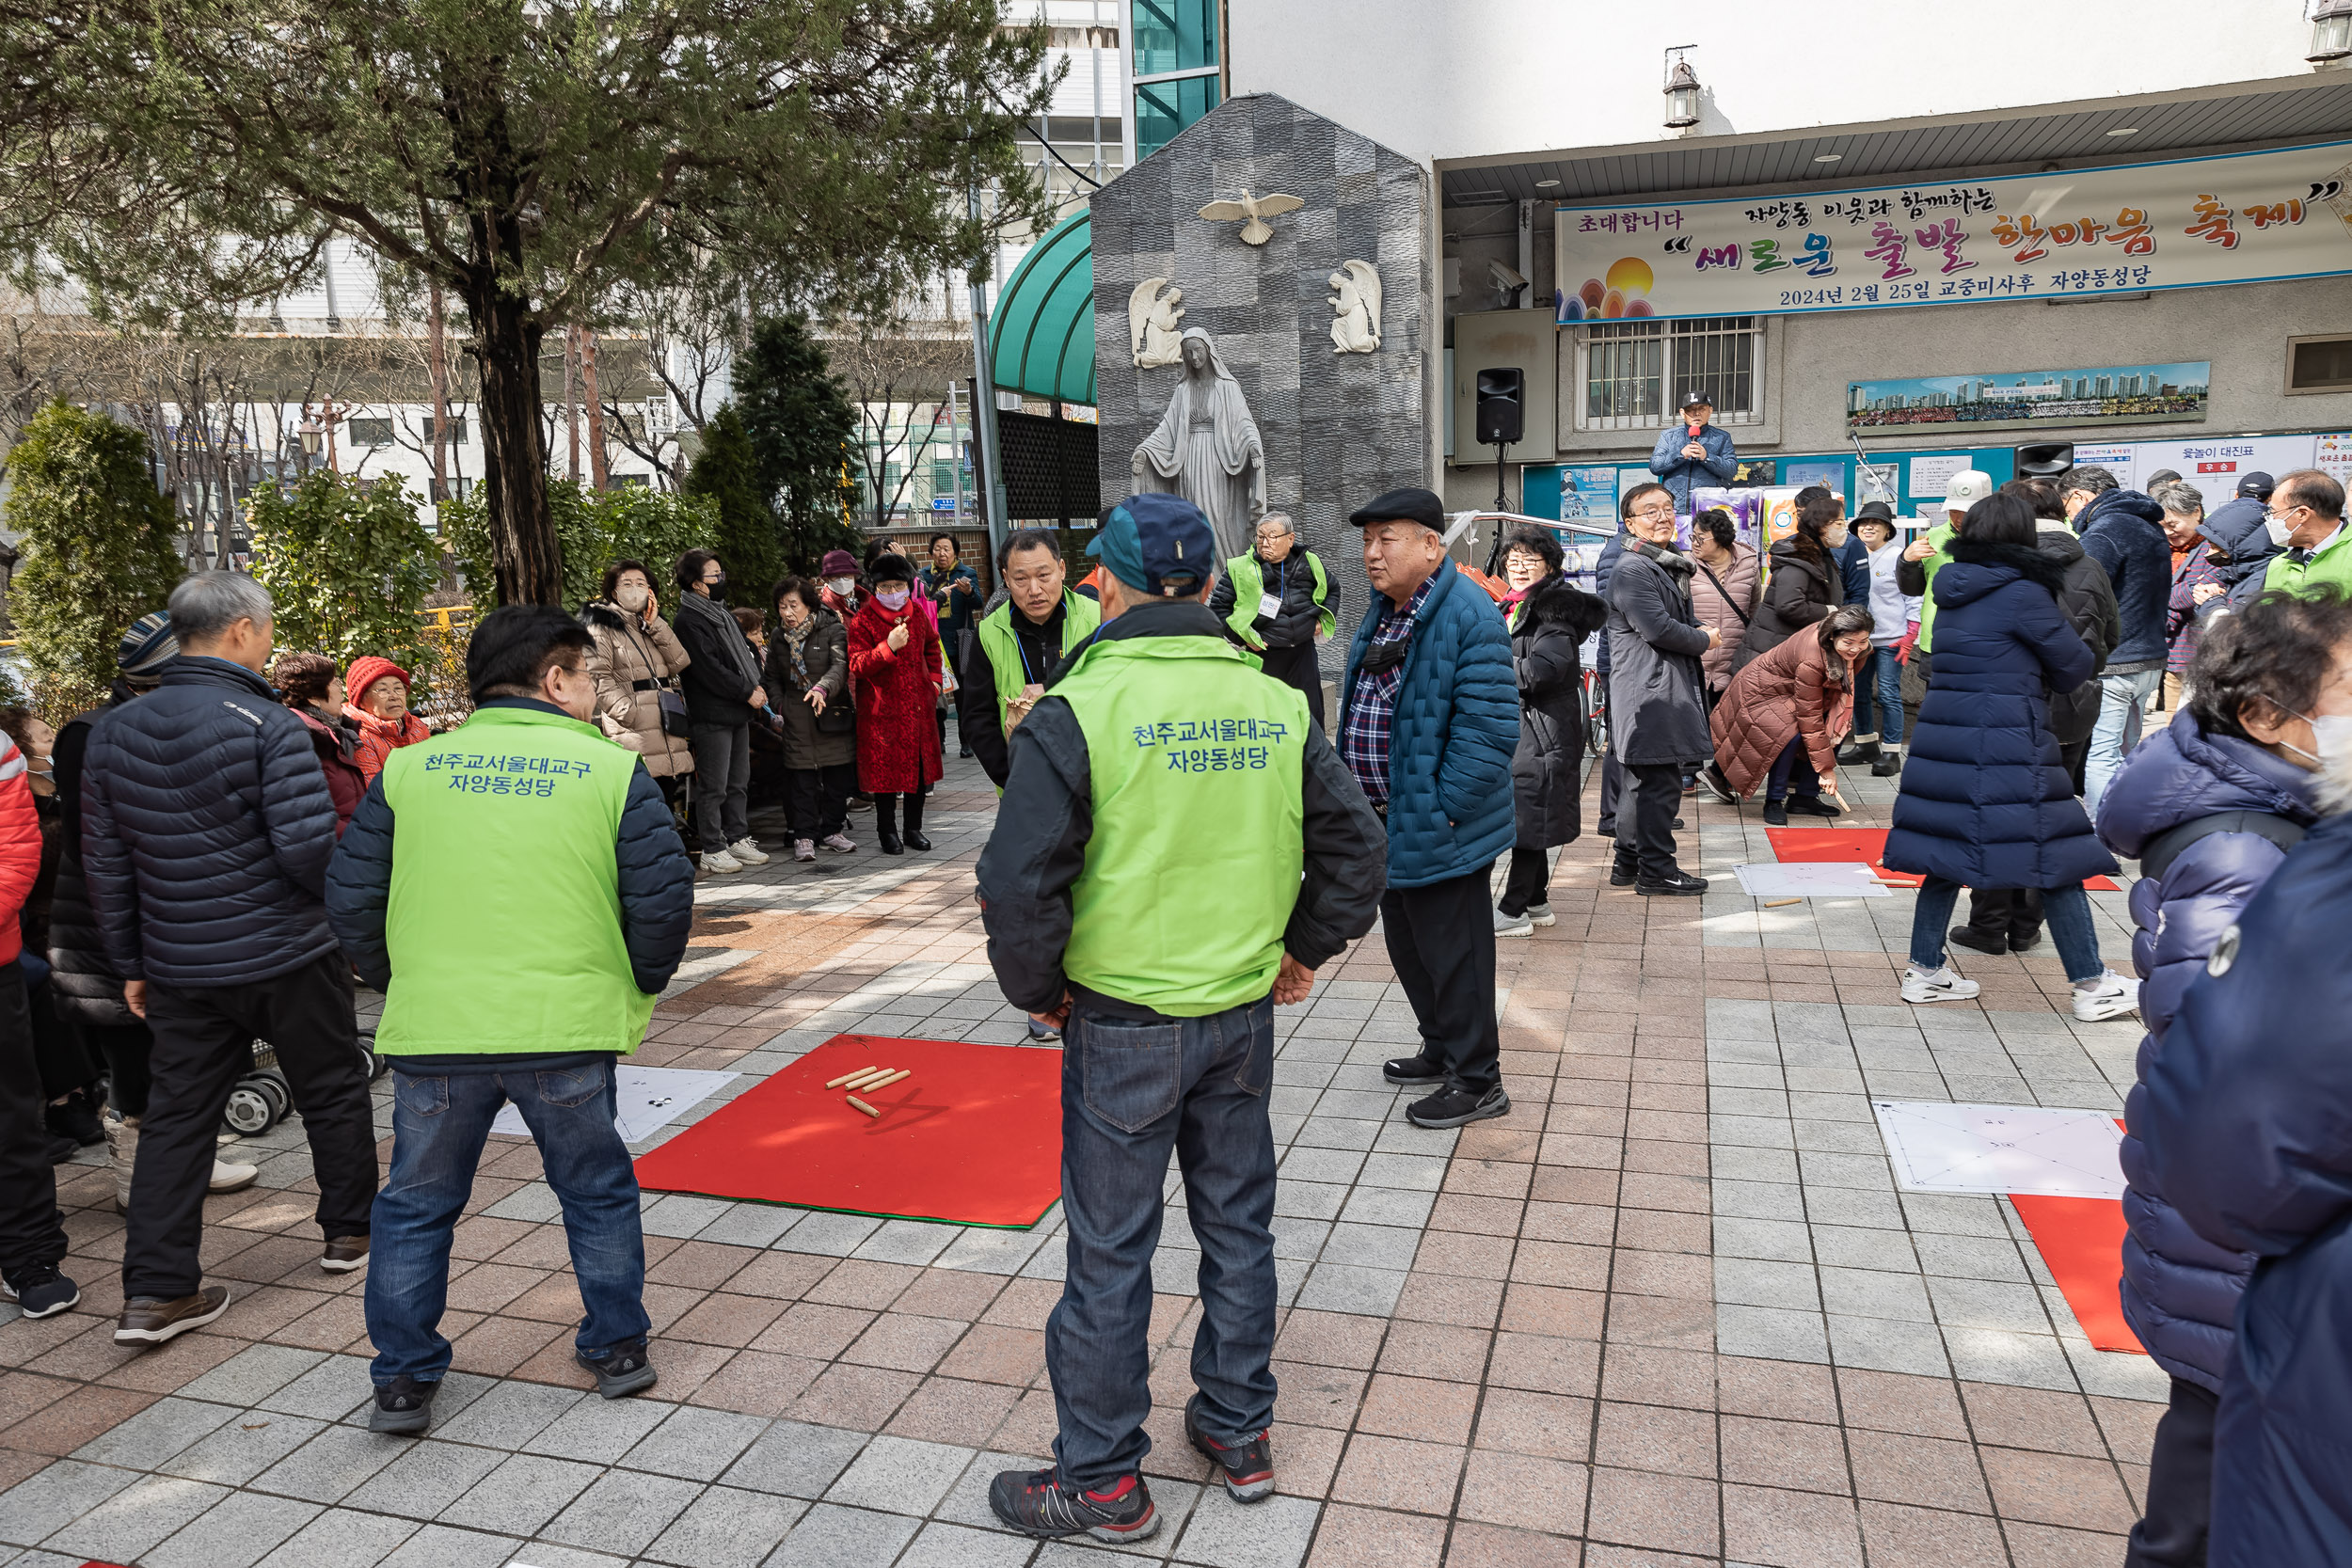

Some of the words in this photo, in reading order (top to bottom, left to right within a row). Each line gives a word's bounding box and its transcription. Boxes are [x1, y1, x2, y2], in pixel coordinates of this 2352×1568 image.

[1577, 210, 1685, 234] 초대합니다
[1745, 200, 1812, 229] 자양동
[1823, 195, 1894, 224] 이웃과
[1900, 188, 1996, 220] 함께하는
[1864, 217, 1979, 281] 출발
[1990, 207, 2157, 263] 한마음
[1780, 286, 1843, 307] 2024년
[1851, 282, 1880, 303] 2월
[1889, 279, 1931, 300] 25일
[1938, 273, 2035, 297] 교중미사후
[2049, 264, 2153, 292] 자양동성당
[2183, 447, 2217, 459] 윷놀이
[2220, 446, 2254, 458] 대진표
[1132, 718, 1288, 748] 천주교서울대교구
[424, 752, 592, 779] 천주교서울대교구
[1168, 746, 1269, 773] 자양동성당
[448, 774, 556, 798] 자양동성당
